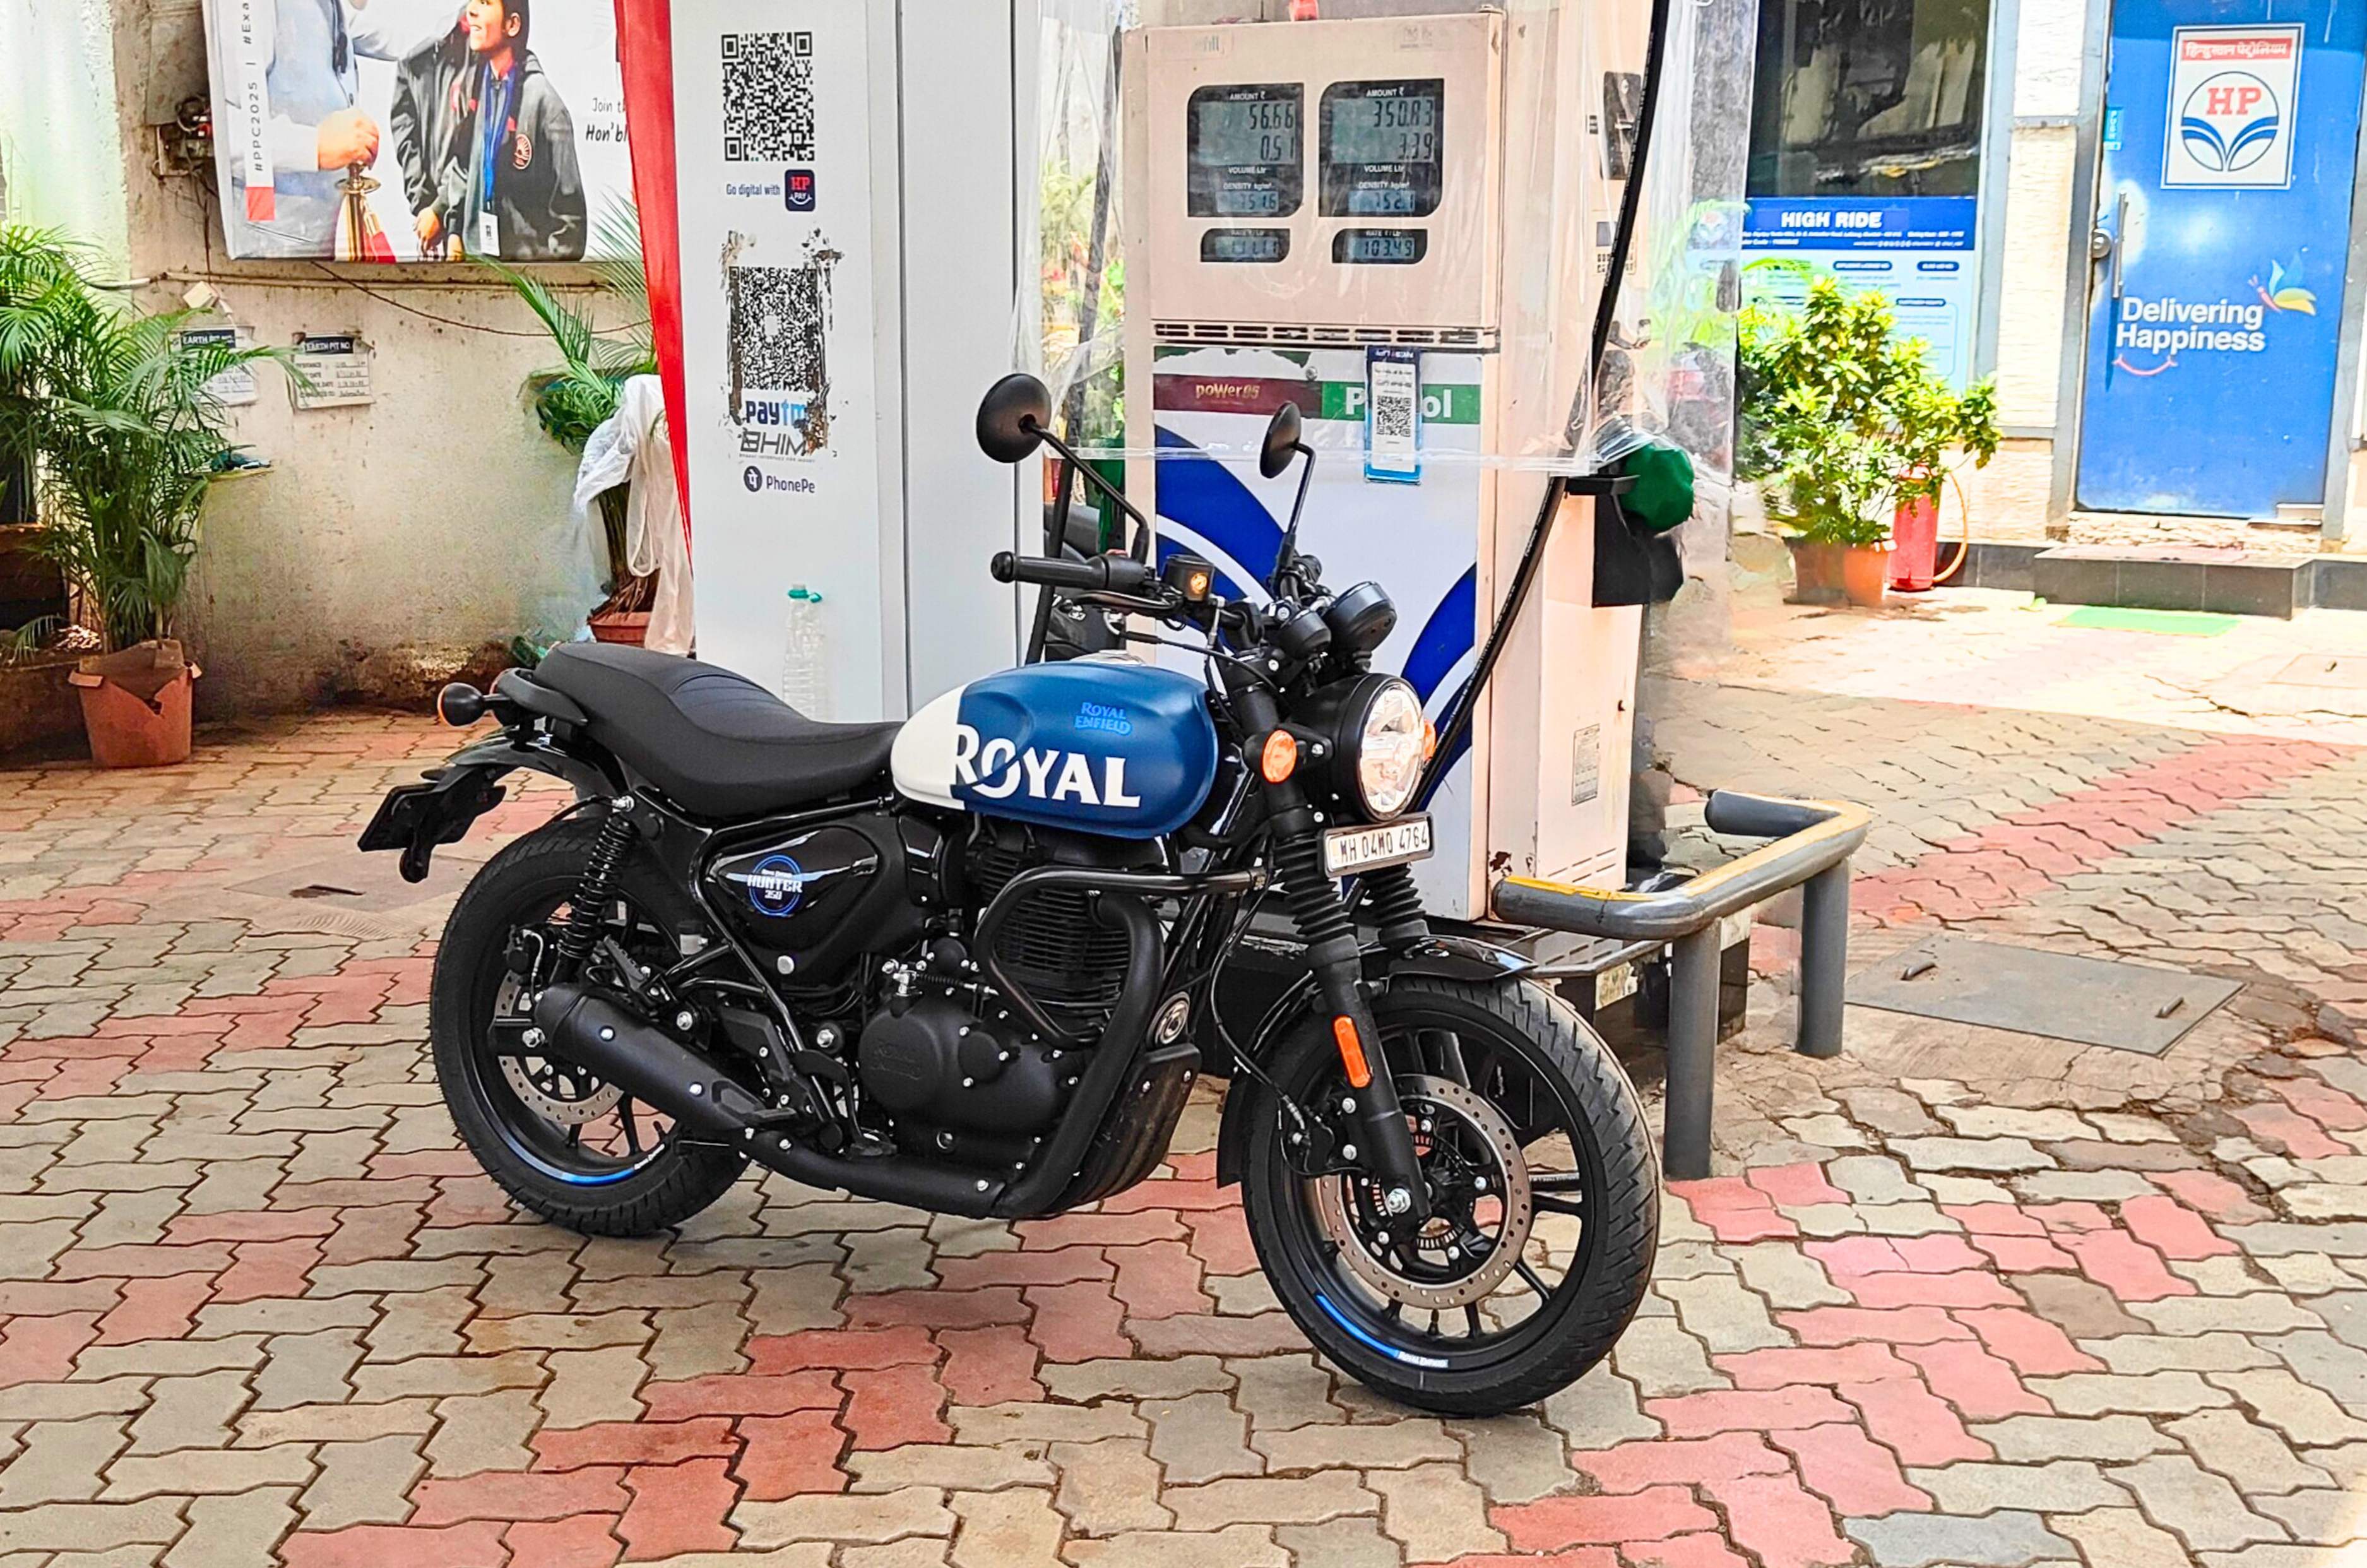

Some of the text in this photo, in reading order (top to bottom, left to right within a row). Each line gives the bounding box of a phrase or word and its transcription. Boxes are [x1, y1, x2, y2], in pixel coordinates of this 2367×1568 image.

[242, 2, 252, 44] #Exa
[1366, 88, 1397, 97] AMOUNT
[2206, 86, 2262, 116] HP
[592, 97, 612, 112] Join
[249, 82, 263, 172] #PPC2025
[586, 121, 629, 142] Hon'bl
[726, 184, 780, 198] Go digital with
[790, 176, 810, 191] HP
[1781, 211, 1883, 228] HIGH RIDE
[2122, 297, 2264, 330] Delivering
[183, 336, 208, 345] EARTH
[2116, 323, 2265, 354] Happiness
[1345, 386, 1452, 419] Pol
[740, 431, 807, 456] BHIM
[766, 475, 816, 493] PhonePe
[1081, 701, 1127, 720] ROYAL
[1074, 715, 1132, 735] ENFIELD
[951, 723, 1141, 808] ROYAL
[1339, 837, 1357, 864] MH
[747, 874, 803, 893] HUNTER
